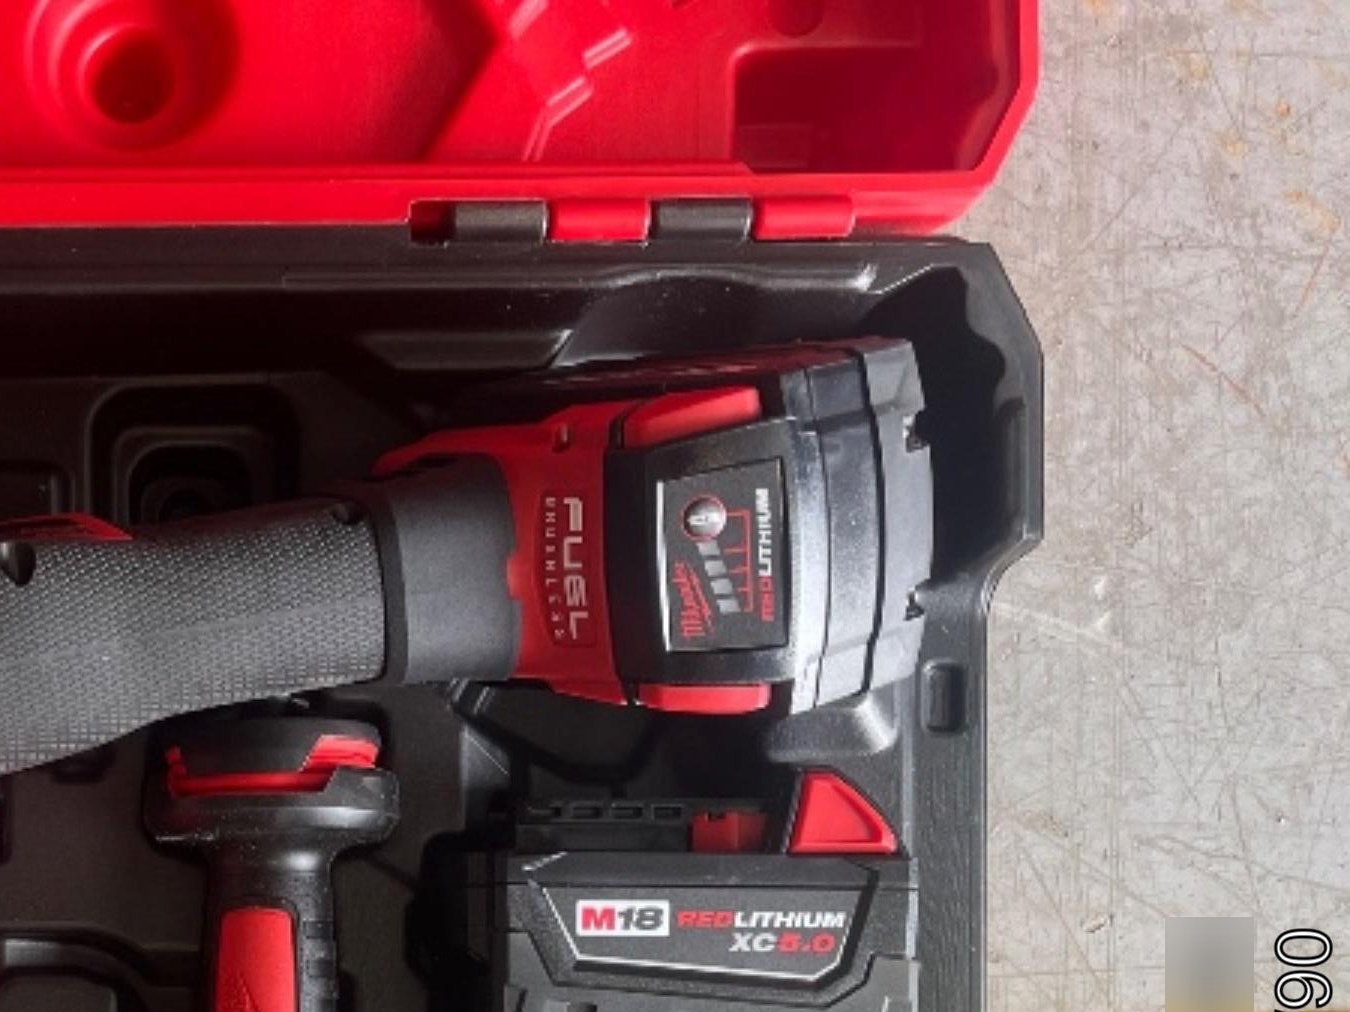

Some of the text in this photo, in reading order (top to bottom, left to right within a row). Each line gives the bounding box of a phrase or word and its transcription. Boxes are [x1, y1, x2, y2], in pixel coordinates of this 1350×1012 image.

[563, 497, 589, 640] FUEL
[581, 908, 664, 930] M18
[677, 911, 847, 929] REDLITHIUM
[729, 932, 836, 954] XC5.0
